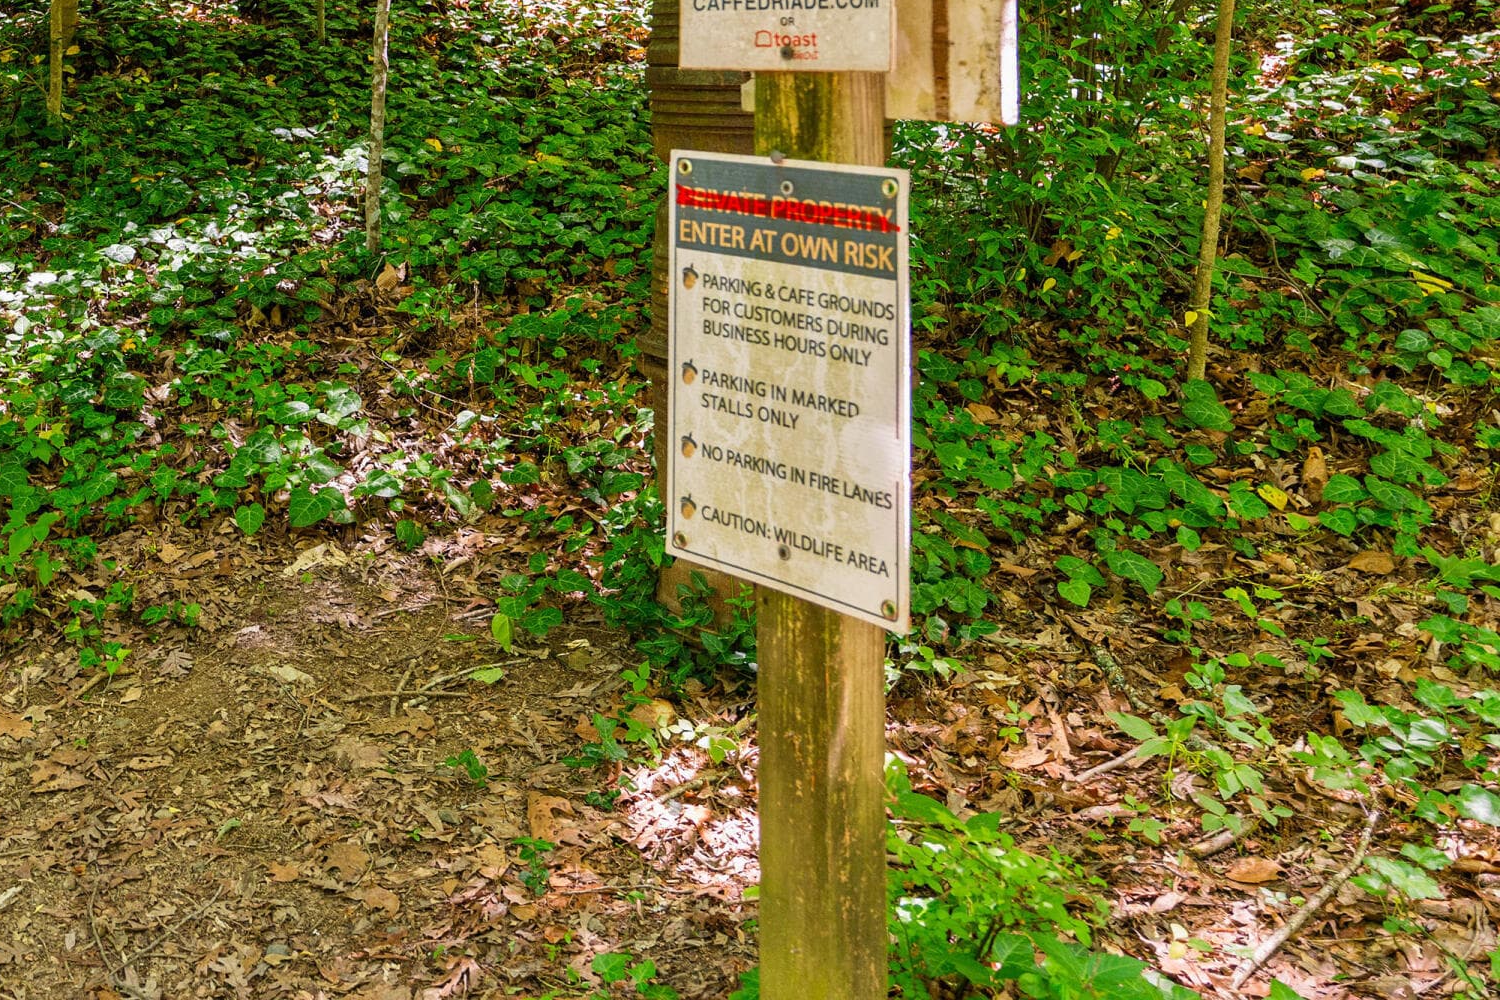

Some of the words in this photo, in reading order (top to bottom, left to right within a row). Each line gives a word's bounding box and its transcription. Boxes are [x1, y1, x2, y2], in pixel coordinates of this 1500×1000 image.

[774, 32, 817, 47] toast
[780, 16, 795, 26] OR
[679, 186, 766, 218] PRIVATE
[771, 195, 893, 233] PROPERTY
[679, 220, 745, 249] ENTER
[750, 230, 777, 253] AT
[780, 233, 838, 263] OWN
[844, 241, 895, 272] RISK
[702, 273, 762, 297] PARKING
[764, 282, 776, 299] &
[778, 285, 815, 307] CAFE
[818, 292, 895, 320] GROUNDS
[702, 297, 730, 316] FOR
[733, 302, 823, 333] CUSTOMERS
[827, 318, 889, 346] DURING
[702, 319, 770, 346] BUSINESS
[774, 332, 826, 358] HOURS
[830, 344, 872, 367] ONLY
[701, 369, 766, 398] PARKING
[771, 384, 787, 402] IN
[792, 390, 860, 418] MARKED
[701, 393, 752, 418] STALLS
[758, 406, 799, 430] ONLY
[701, 443, 723, 462] NO
[726, 450, 787, 480] PARKING
[790, 467, 806, 485] IN
[809, 472, 840, 496] FIRE
[843, 481, 893, 510] LANES
[701, 505, 771, 539] CAUTION:
[774, 525, 843, 562] WILDLIFE
[847, 550, 890, 578] AREA
